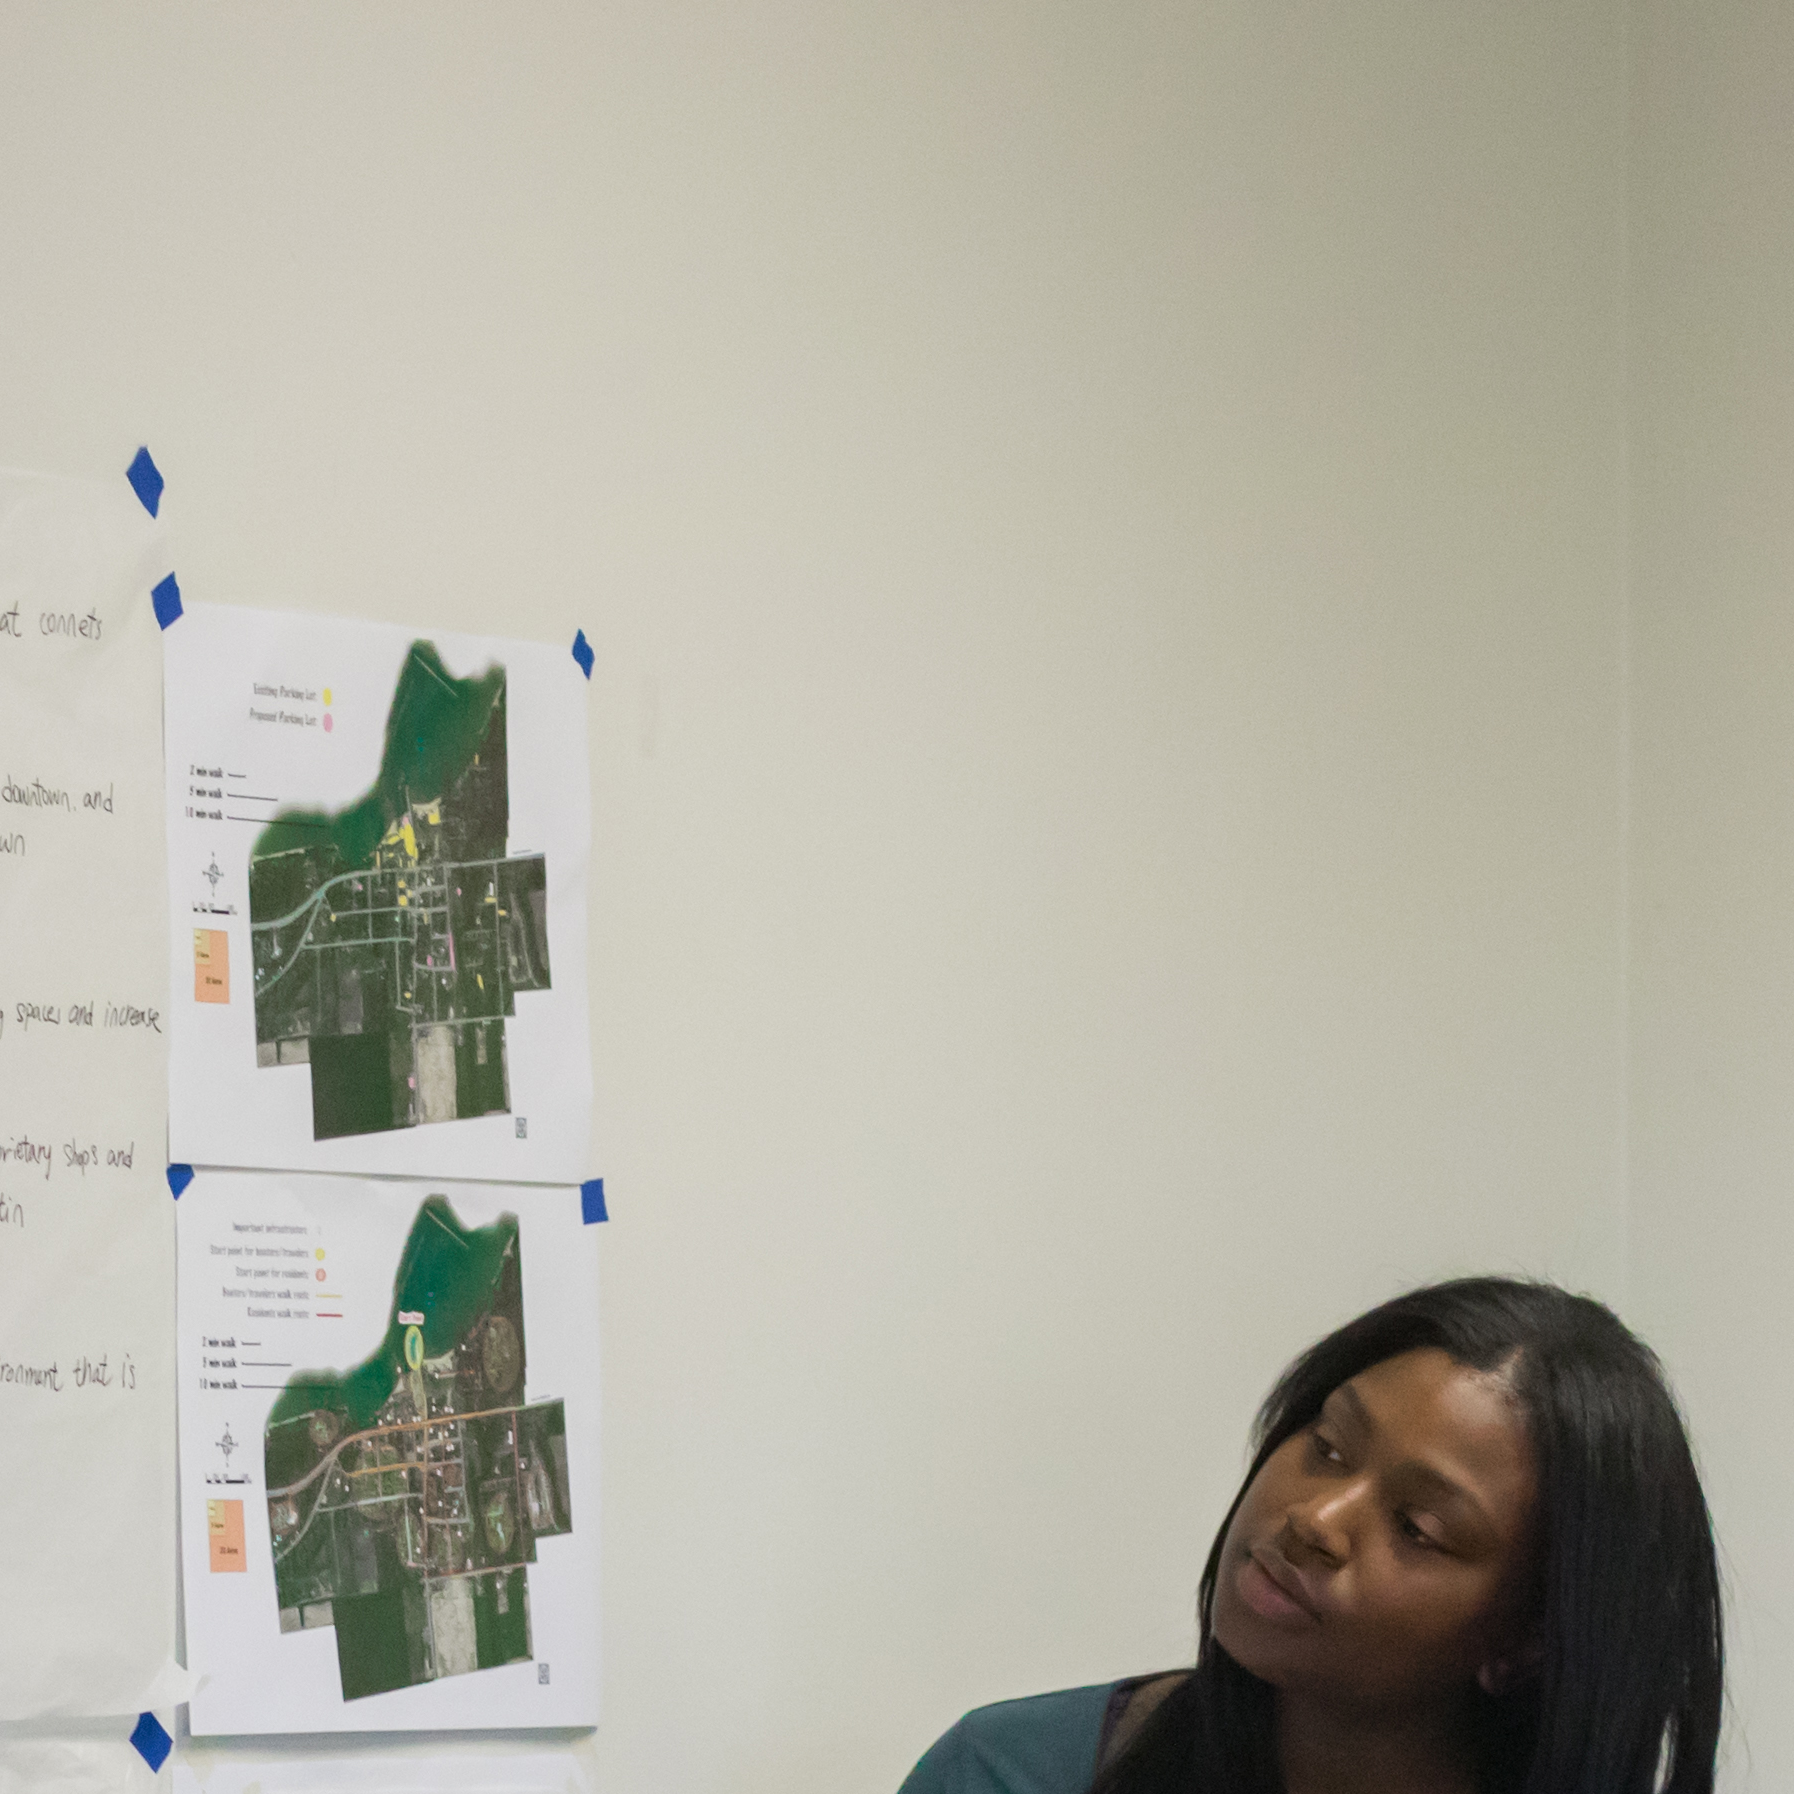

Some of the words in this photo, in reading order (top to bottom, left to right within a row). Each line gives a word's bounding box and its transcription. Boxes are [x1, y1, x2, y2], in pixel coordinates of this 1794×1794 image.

[83, 783, 114, 814] and
[15, 1000, 62, 1033] spaces
[68, 1001, 95, 1029] and
[104, 996, 163, 1035] increase
[106, 1141, 136, 1170] and
[72, 1354, 115, 1390] that
[120, 1352, 137, 1390] is
